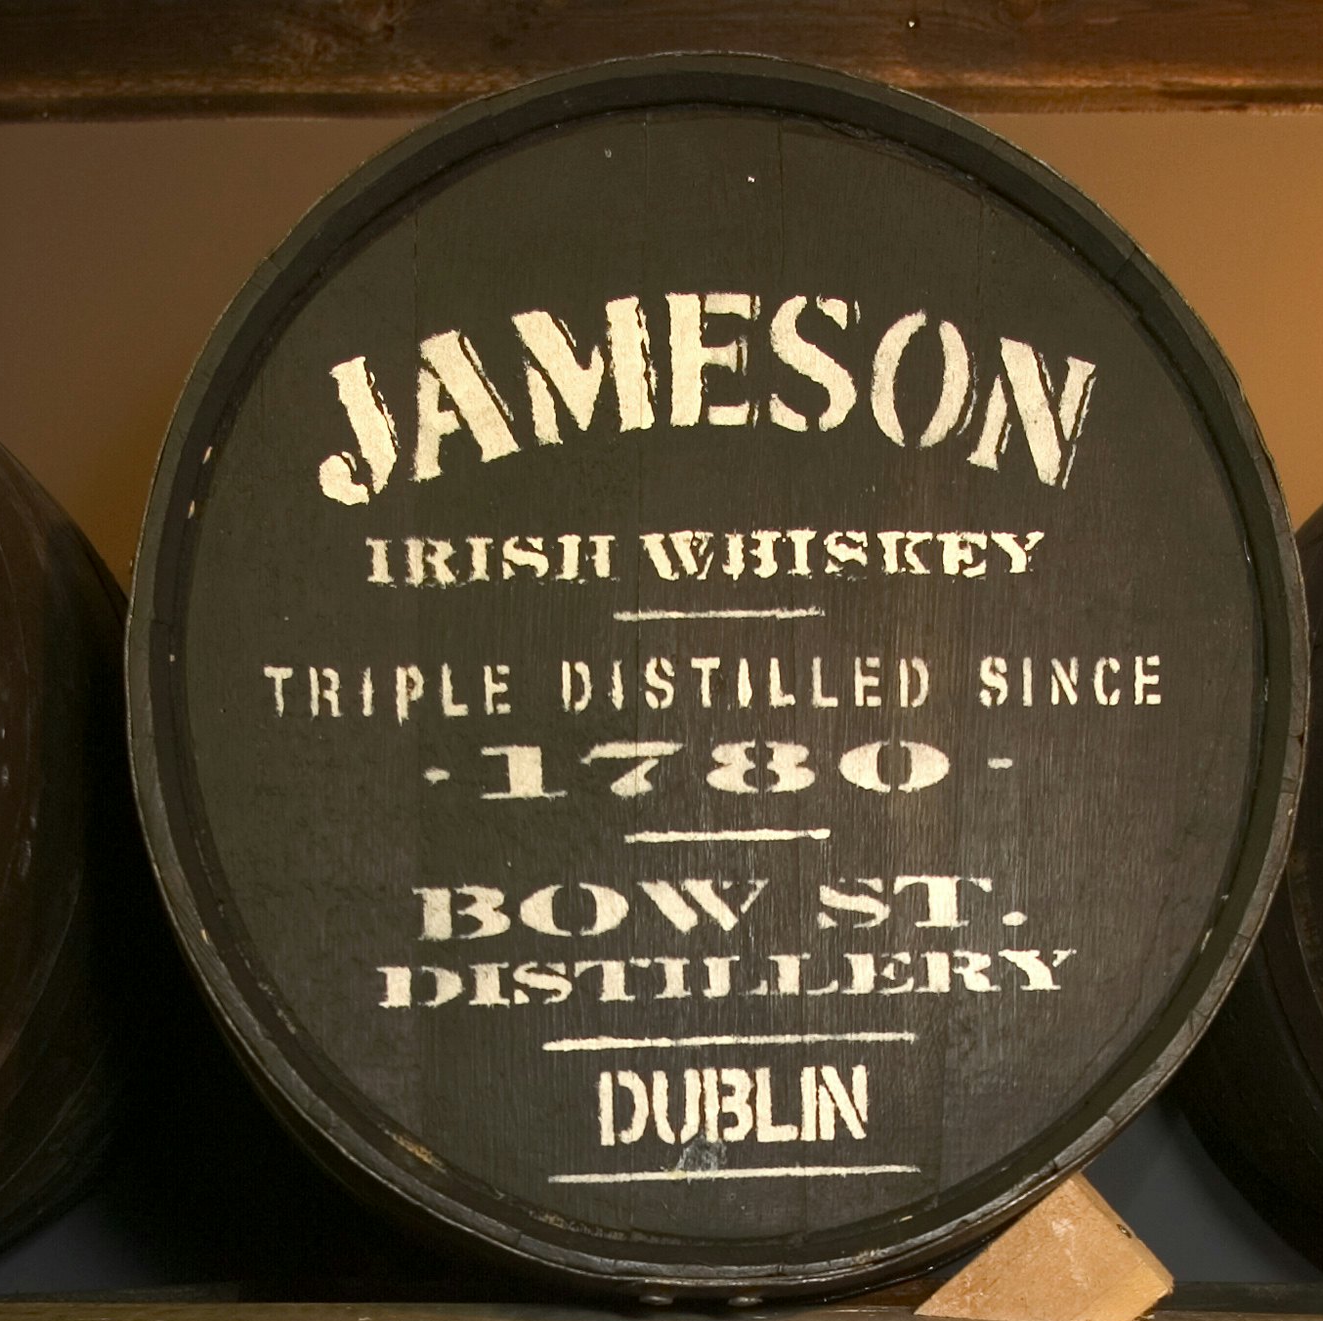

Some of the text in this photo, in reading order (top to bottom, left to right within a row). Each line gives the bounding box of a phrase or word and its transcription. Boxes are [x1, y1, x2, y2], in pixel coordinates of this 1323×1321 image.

[316, 290, 1098, 507] JAMESON
[364, 528, 1046, 586] IRISH WHISKEY
[263, 652, 1165, 726] TRIPLE DISTILLED SINCE
[410, 875, 1026, 942] BOW ST.
[376, 948, 1078, 1009] DISTILLERY
[598, 1064, 871, 1147] DUBLIN
